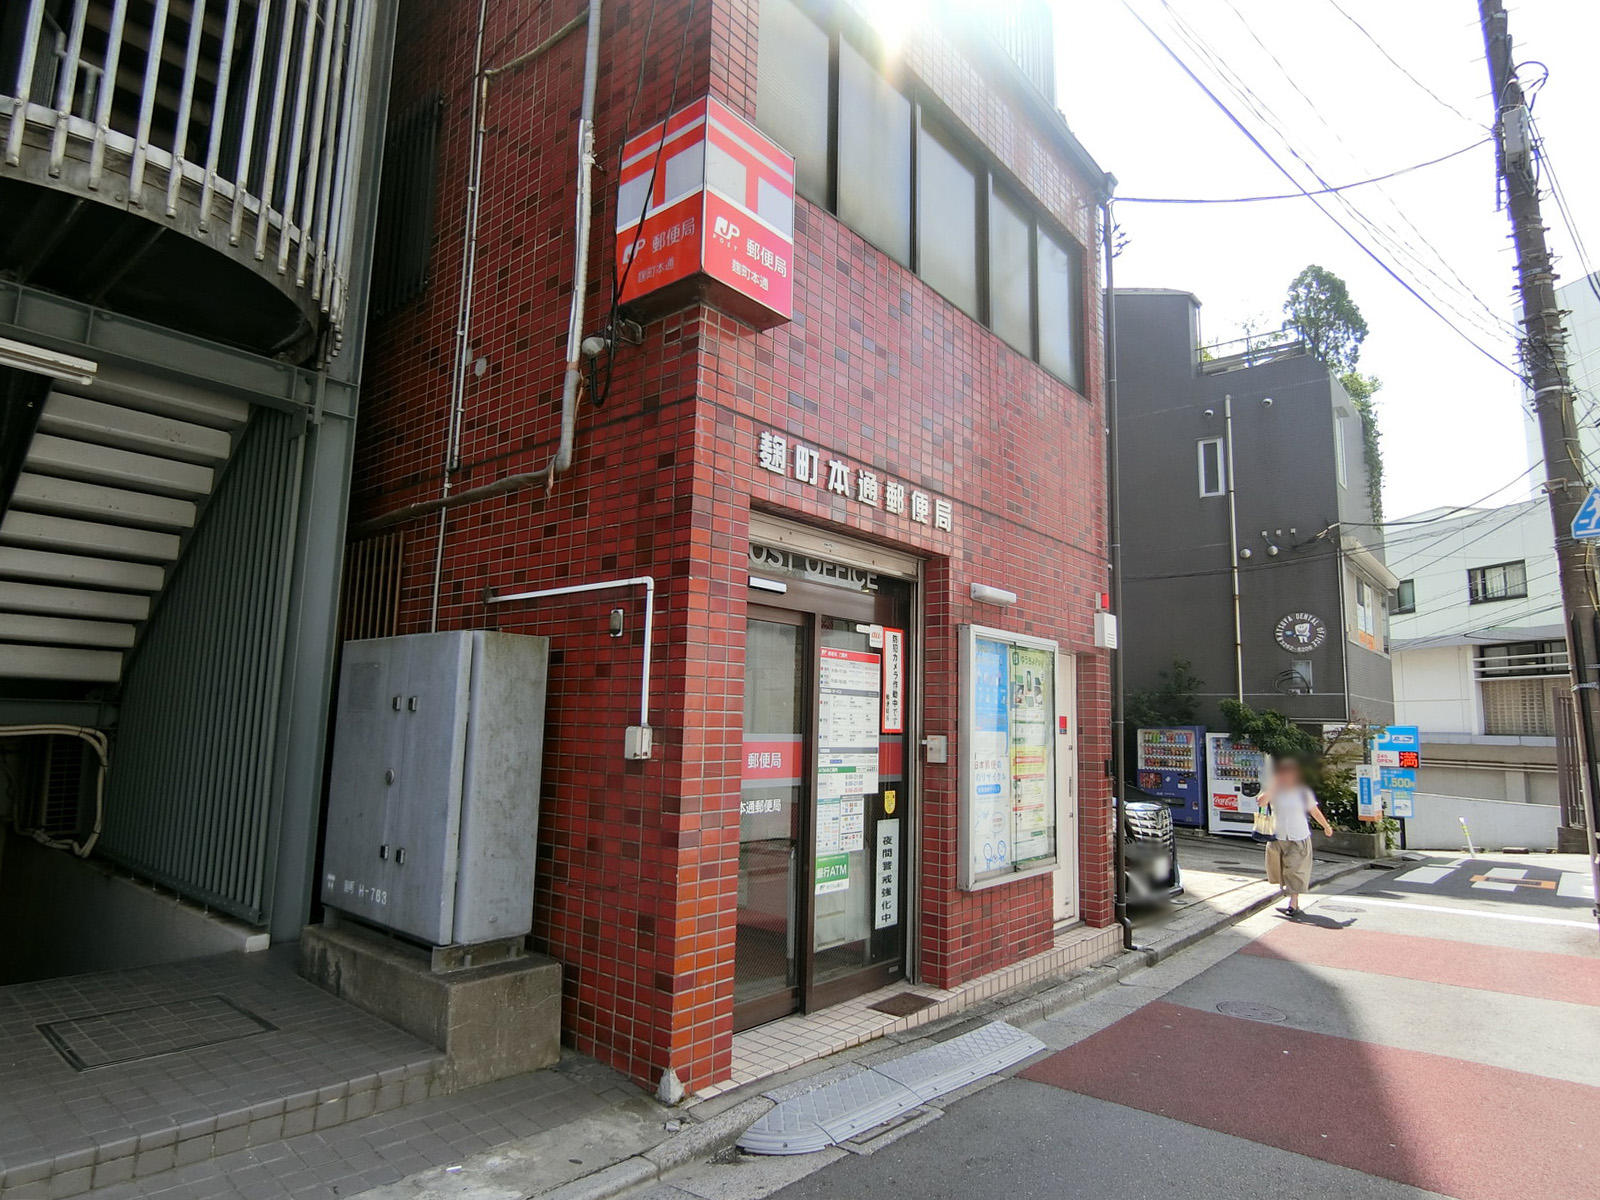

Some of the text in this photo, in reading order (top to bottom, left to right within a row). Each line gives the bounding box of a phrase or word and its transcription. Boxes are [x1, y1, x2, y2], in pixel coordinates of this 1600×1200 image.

[652, 217, 695, 253] 郵便局
[712, 234, 738, 252] POST
[746, 239, 787, 278] 郵便局
[1295, 612, 1319, 626] DENTAL
[1311, 627, 1325, 647] OFFICE
[748, 752, 782, 768] 郵便局
[881, 835, 893, 923] 夜間警戒強化中
